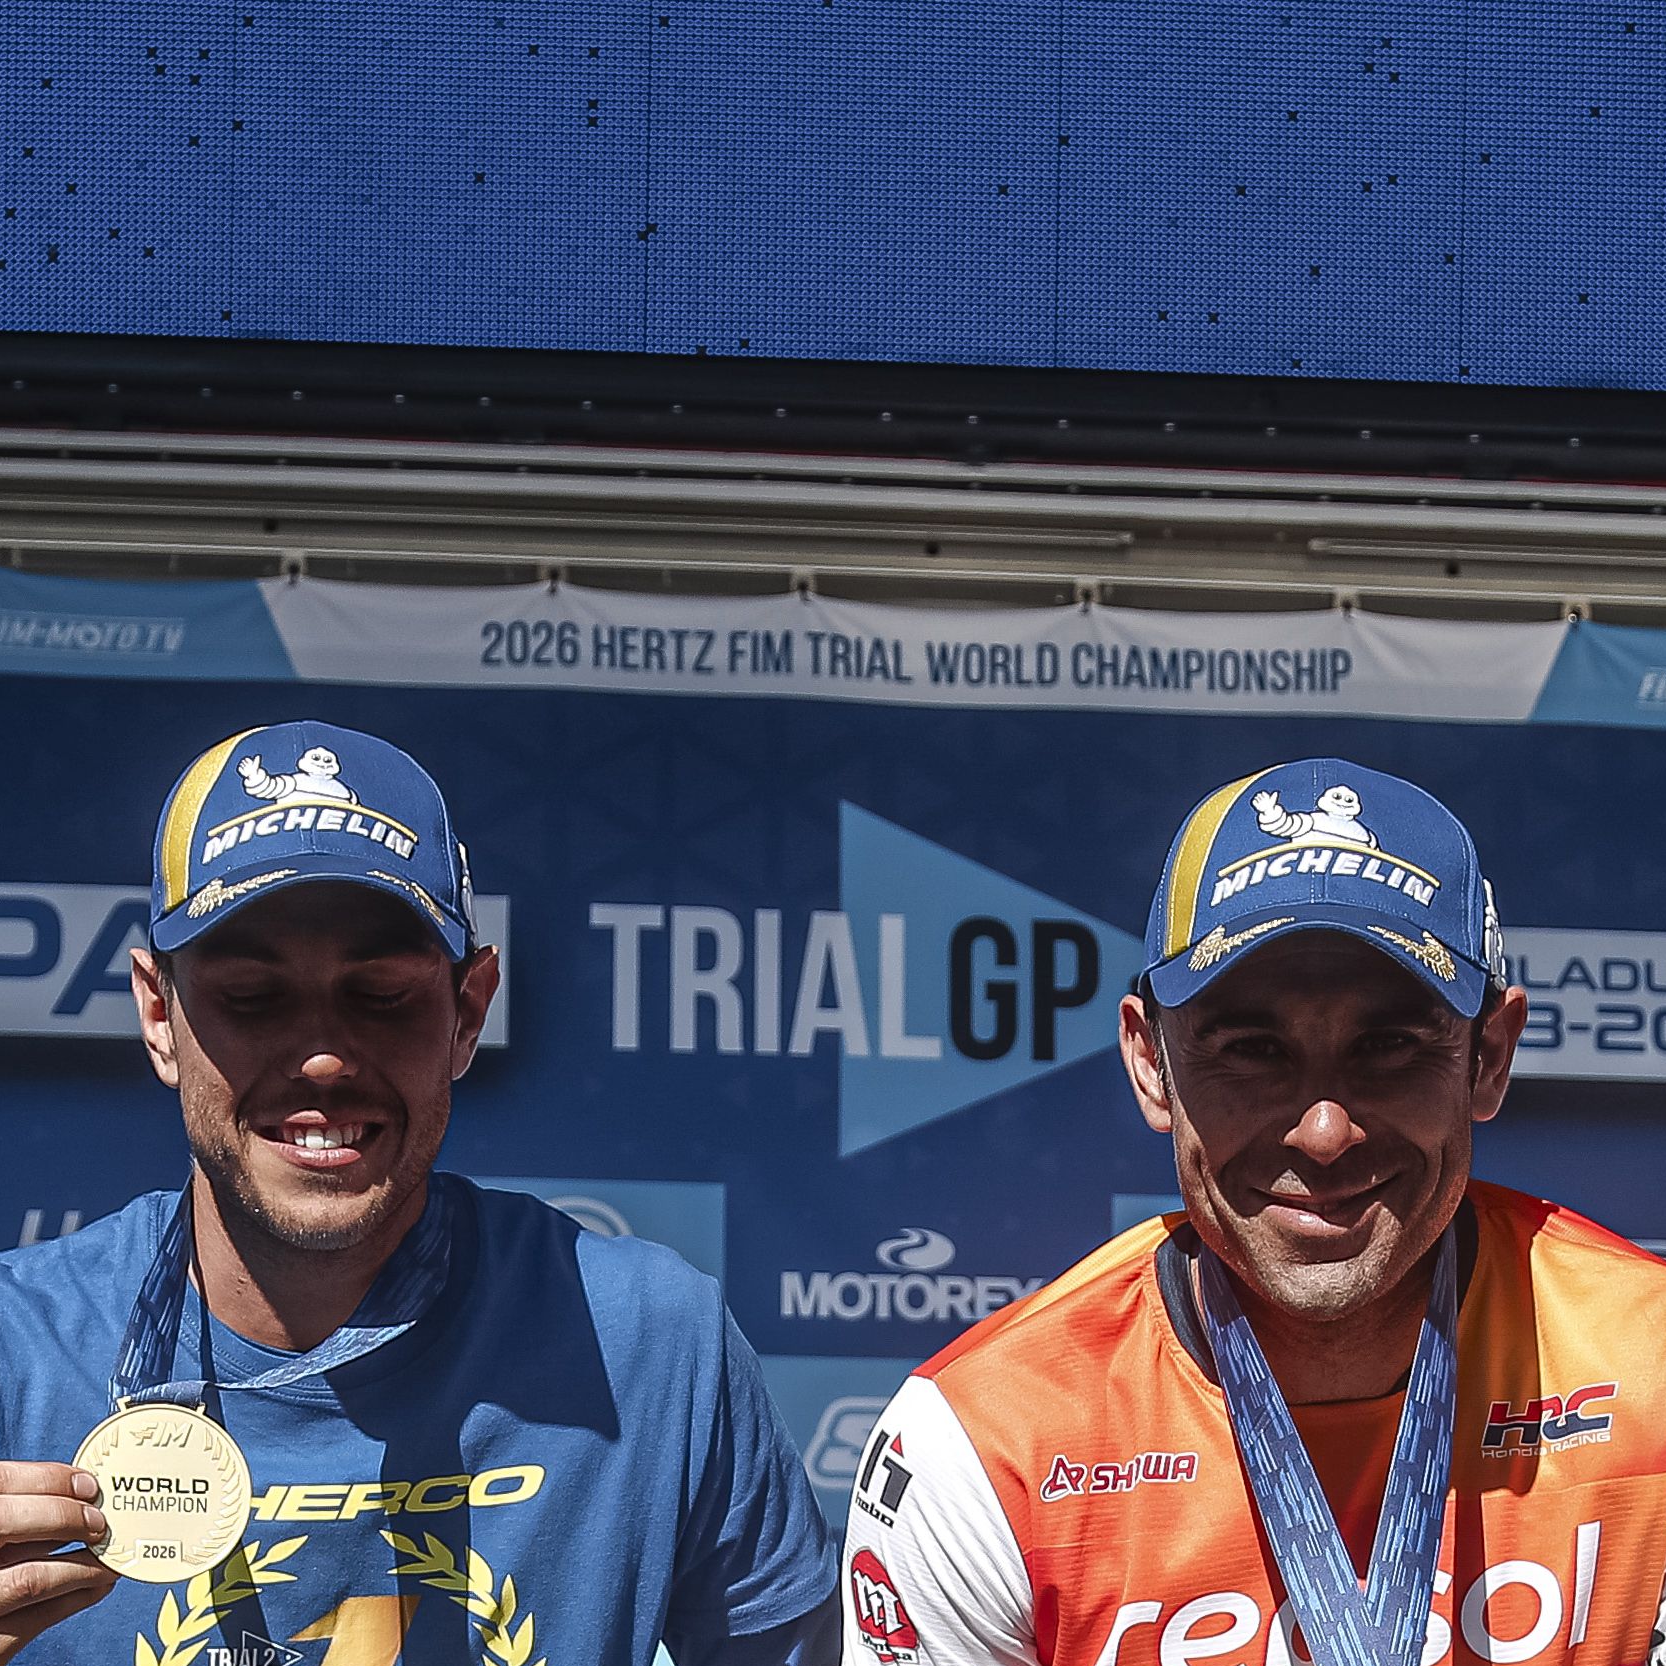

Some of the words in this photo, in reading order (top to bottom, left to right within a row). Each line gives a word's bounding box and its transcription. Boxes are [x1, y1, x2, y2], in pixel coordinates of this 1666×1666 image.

[480, 620, 581, 669] 2026
[592, 624, 715, 673] HERTZ
[728, 628, 794, 676] FIM
[806, 632, 912, 683] TRIAL
[926, 640, 1061, 687] WORLD
[1072, 642, 1352, 694] CHAMPIONSHIP
[200, 804, 416, 866] MICHELIN
[1209, 845, 1441, 908] MICHELIN
[588, 901, 1100, 1064] TRIALGP
[1481, 1380, 1621, 1448] HRC
[1549, 1431, 1612, 1456] RACING
[110, 1475, 210, 1497] WORLD
[111, 1495, 209, 1515] CHAMPION
[250, 1464, 547, 1523] HERCO
[140, 1544, 179, 1562] 2026
